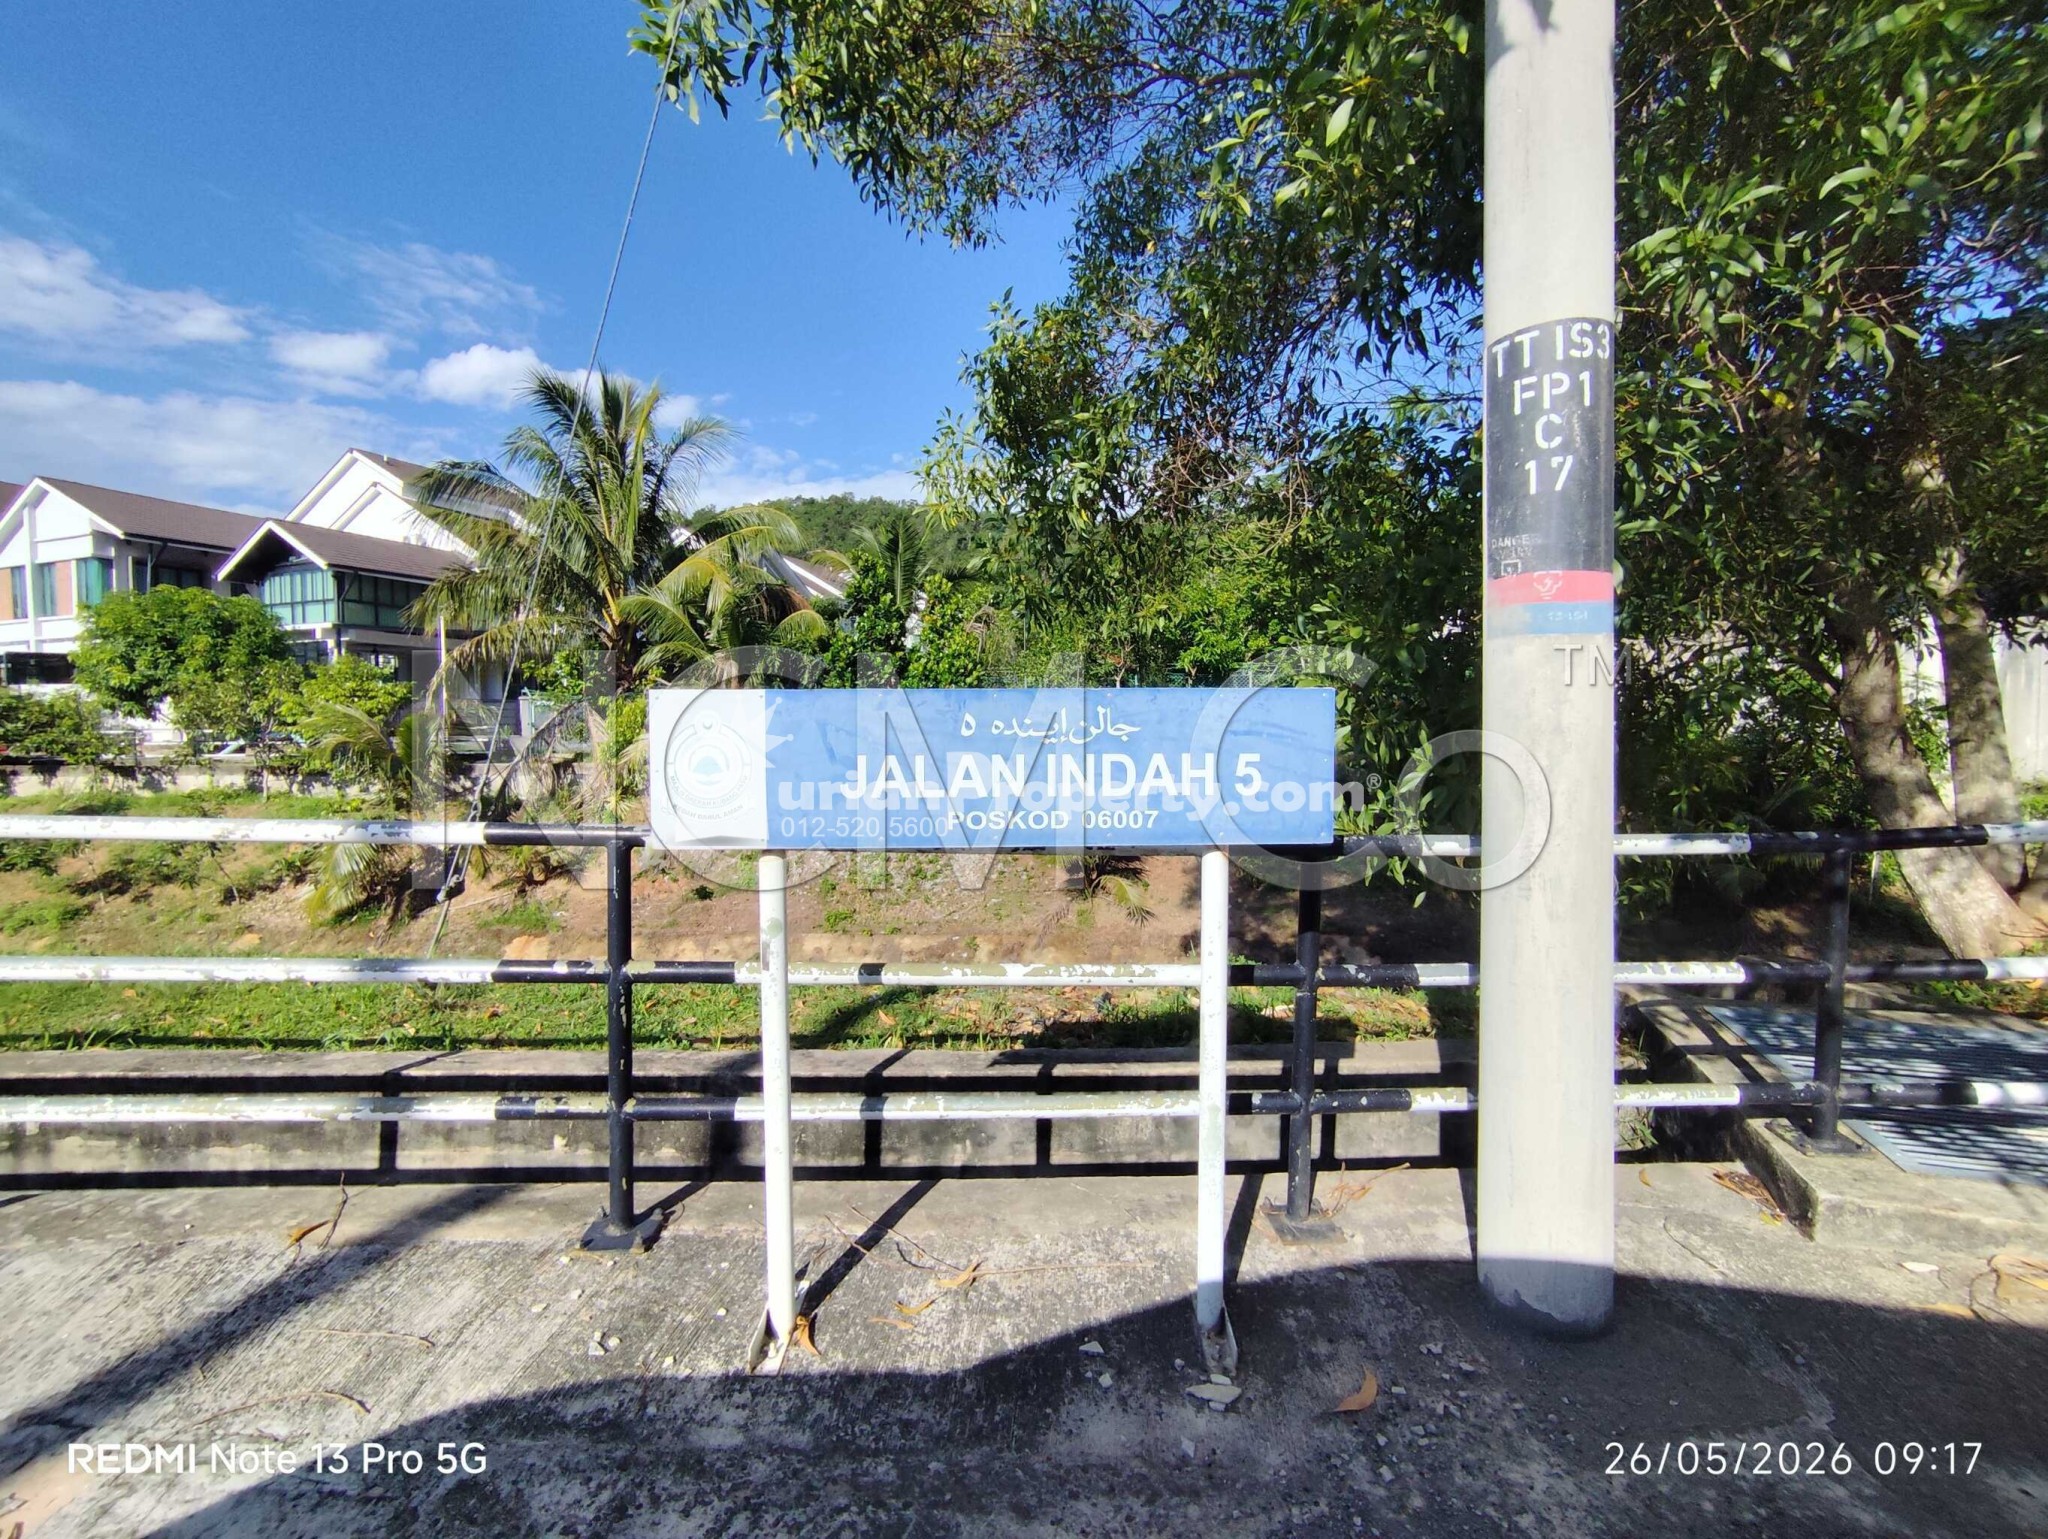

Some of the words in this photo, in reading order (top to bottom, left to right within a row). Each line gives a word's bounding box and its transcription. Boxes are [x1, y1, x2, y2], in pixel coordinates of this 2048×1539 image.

[1492, 330, 1541, 378] TT
[1535, 413, 1564, 449] C
[1524, 454, 1575, 496] 17
[840, 753, 1026, 800] JALAN
[1047, 752, 1216, 798] INDAH
[1234, 752, 1262, 797] 5
[948, 810, 1069, 831] POSKOD
[1081, 809, 1160, 830] 06007
